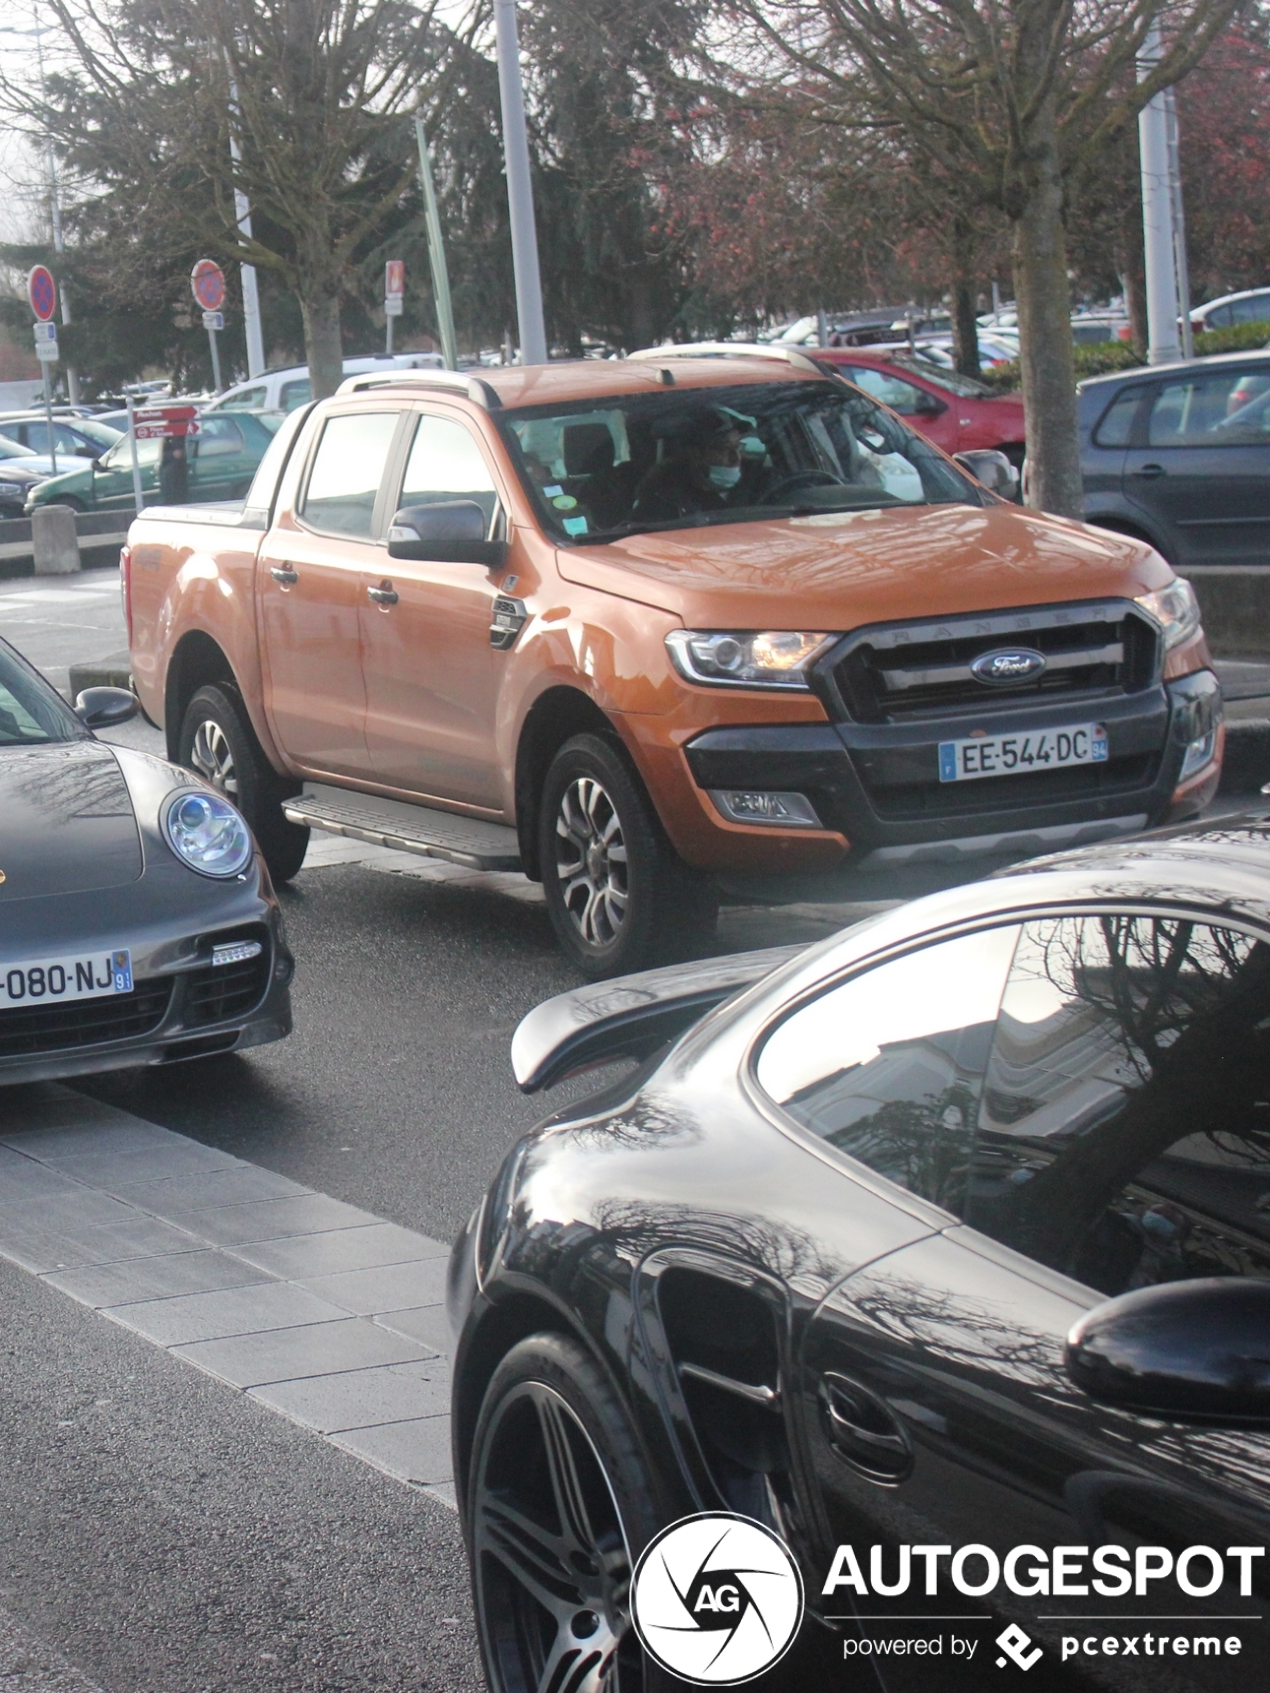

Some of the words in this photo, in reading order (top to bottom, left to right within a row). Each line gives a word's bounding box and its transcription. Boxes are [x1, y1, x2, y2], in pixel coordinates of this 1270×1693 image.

[892, 607, 1107, 643] RANGER
[991, 655, 1030, 674] Ford
[962, 730, 1088, 774] EE-544-DC
[1092, 742, 1106, 757] 94
